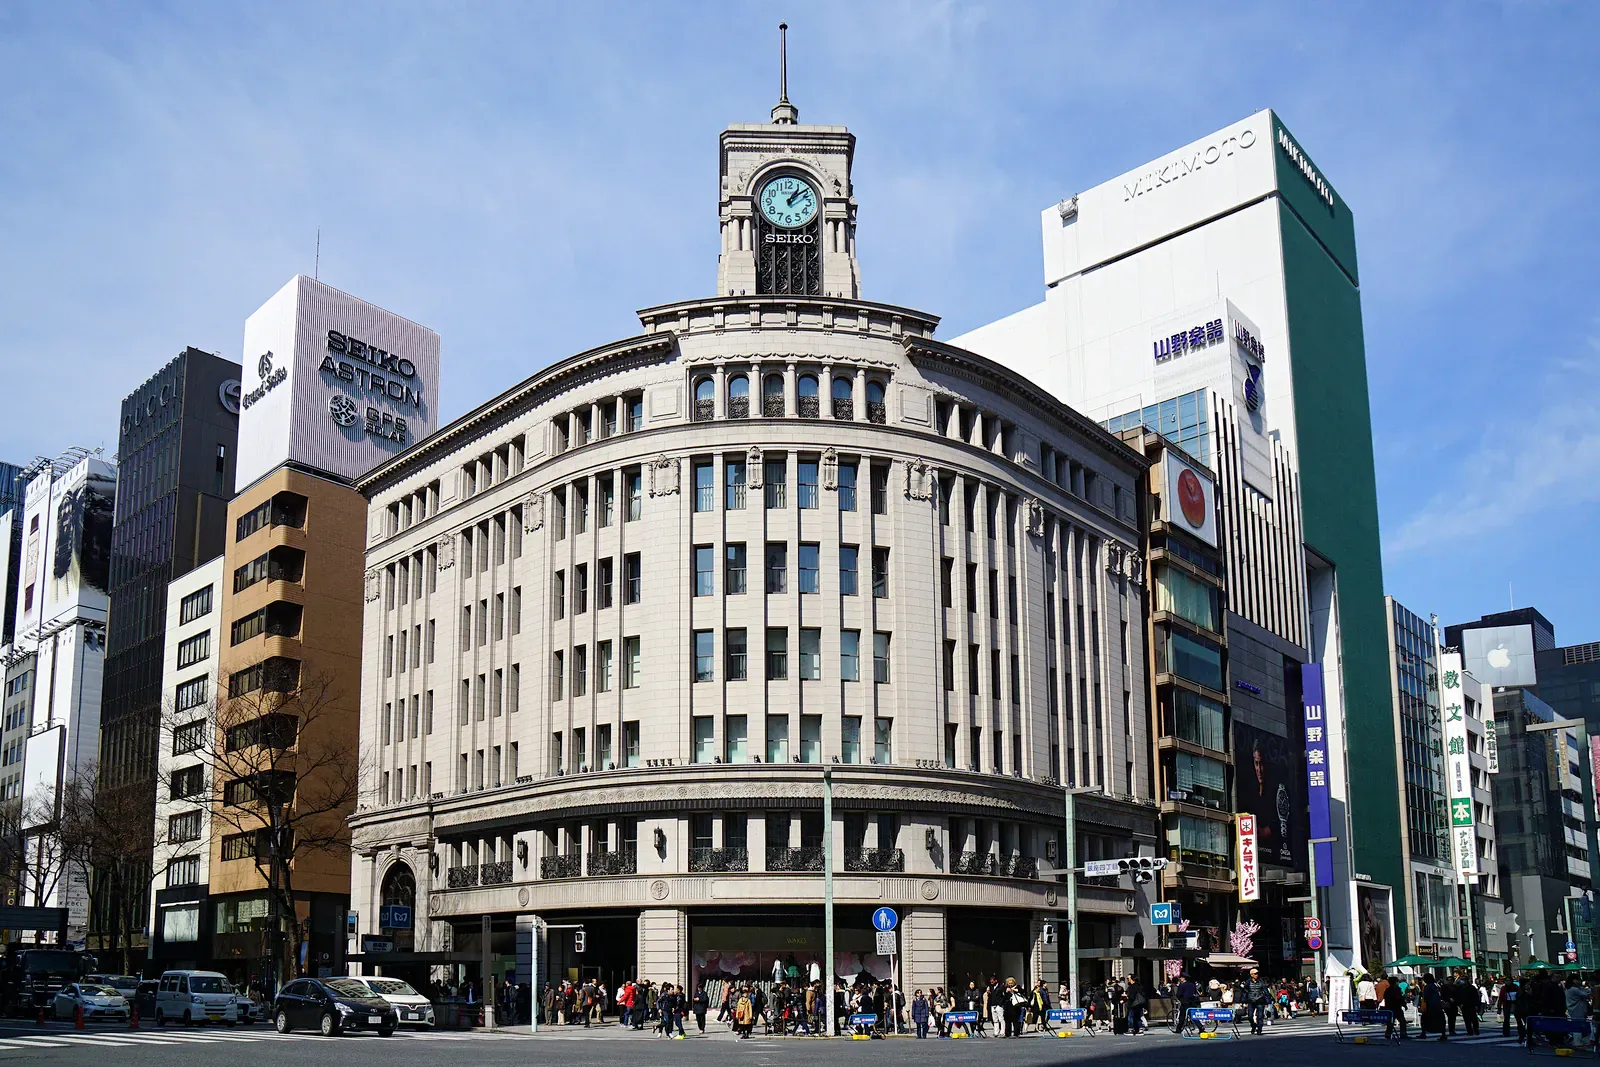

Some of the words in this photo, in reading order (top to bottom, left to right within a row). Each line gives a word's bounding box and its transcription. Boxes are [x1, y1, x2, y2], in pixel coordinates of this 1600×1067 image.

[1123, 128, 1257, 202] MIKIMOTO
[1277, 127, 1334, 206] MIKIMOTO
[776, 182, 782, 191] 11
[784, 181, 792, 190] 12
[805, 199, 812, 207] 3
[768, 206, 776, 214] 8
[785, 215, 792, 223] 6
[794, 213, 801, 221] 5
[802, 207, 809, 216] 4
[765, 234, 814, 244] SEIKO
[326, 329, 416, 379] SEIKO
[1154, 318, 1223, 360] 山野楽器
[243, 380, 266, 410] Grand
[265, 366, 288, 392] Seiko
[318, 355, 420, 408] ASTRON
[122, 377, 177, 436] GUCCI
[366, 406, 407, 432] GPS
[364, 422, 406, 444] SOLAR
[1443, 670, 1465, 755] 教文館
[1306, 705, 1324, 786] 山野楽器
[1485, 720, 1498, 770] 教文館ビル
[1452, 802, 1470, 821] 本
[1242, 838, 1255, 896] キムラヤのパン
[1460, 830, 1470, 868] ナルニア国
